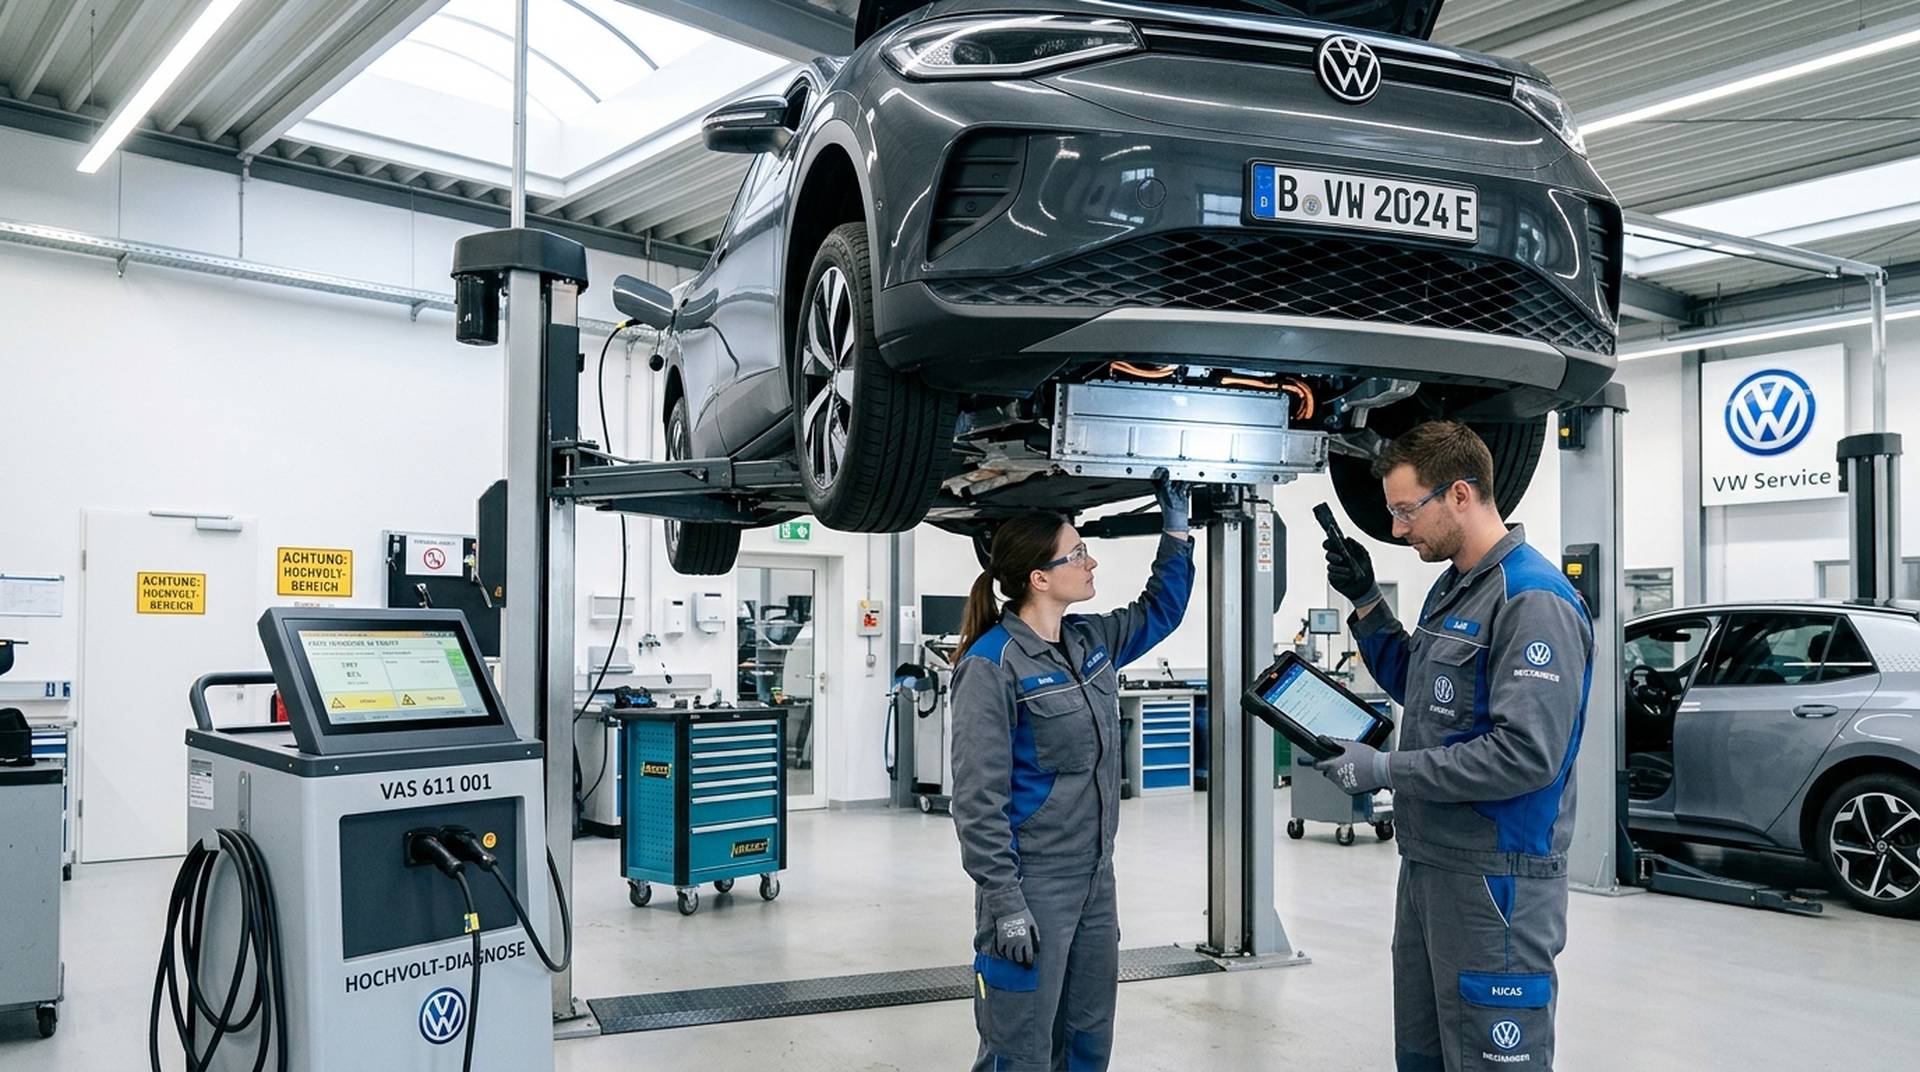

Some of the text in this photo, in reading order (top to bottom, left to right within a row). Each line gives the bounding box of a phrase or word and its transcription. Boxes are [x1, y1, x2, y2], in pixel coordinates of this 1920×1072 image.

[1319, 35, 1381, 101] VW
[1260, 196, 1268, 207] D
[1278, 174, 1298, 212] B
[1324, 179, 1365, 219] VW
[1374, 185, 1449, 229] 2024
[1729, 374, 1809, 450] VW
[1713, 468, 1832, 492] VW Service
[282, 551, 348, 566] ACHTUNG:
[380, 773, 492, 800] VAS 611 001
[421, 989, 465, 1042] VW
